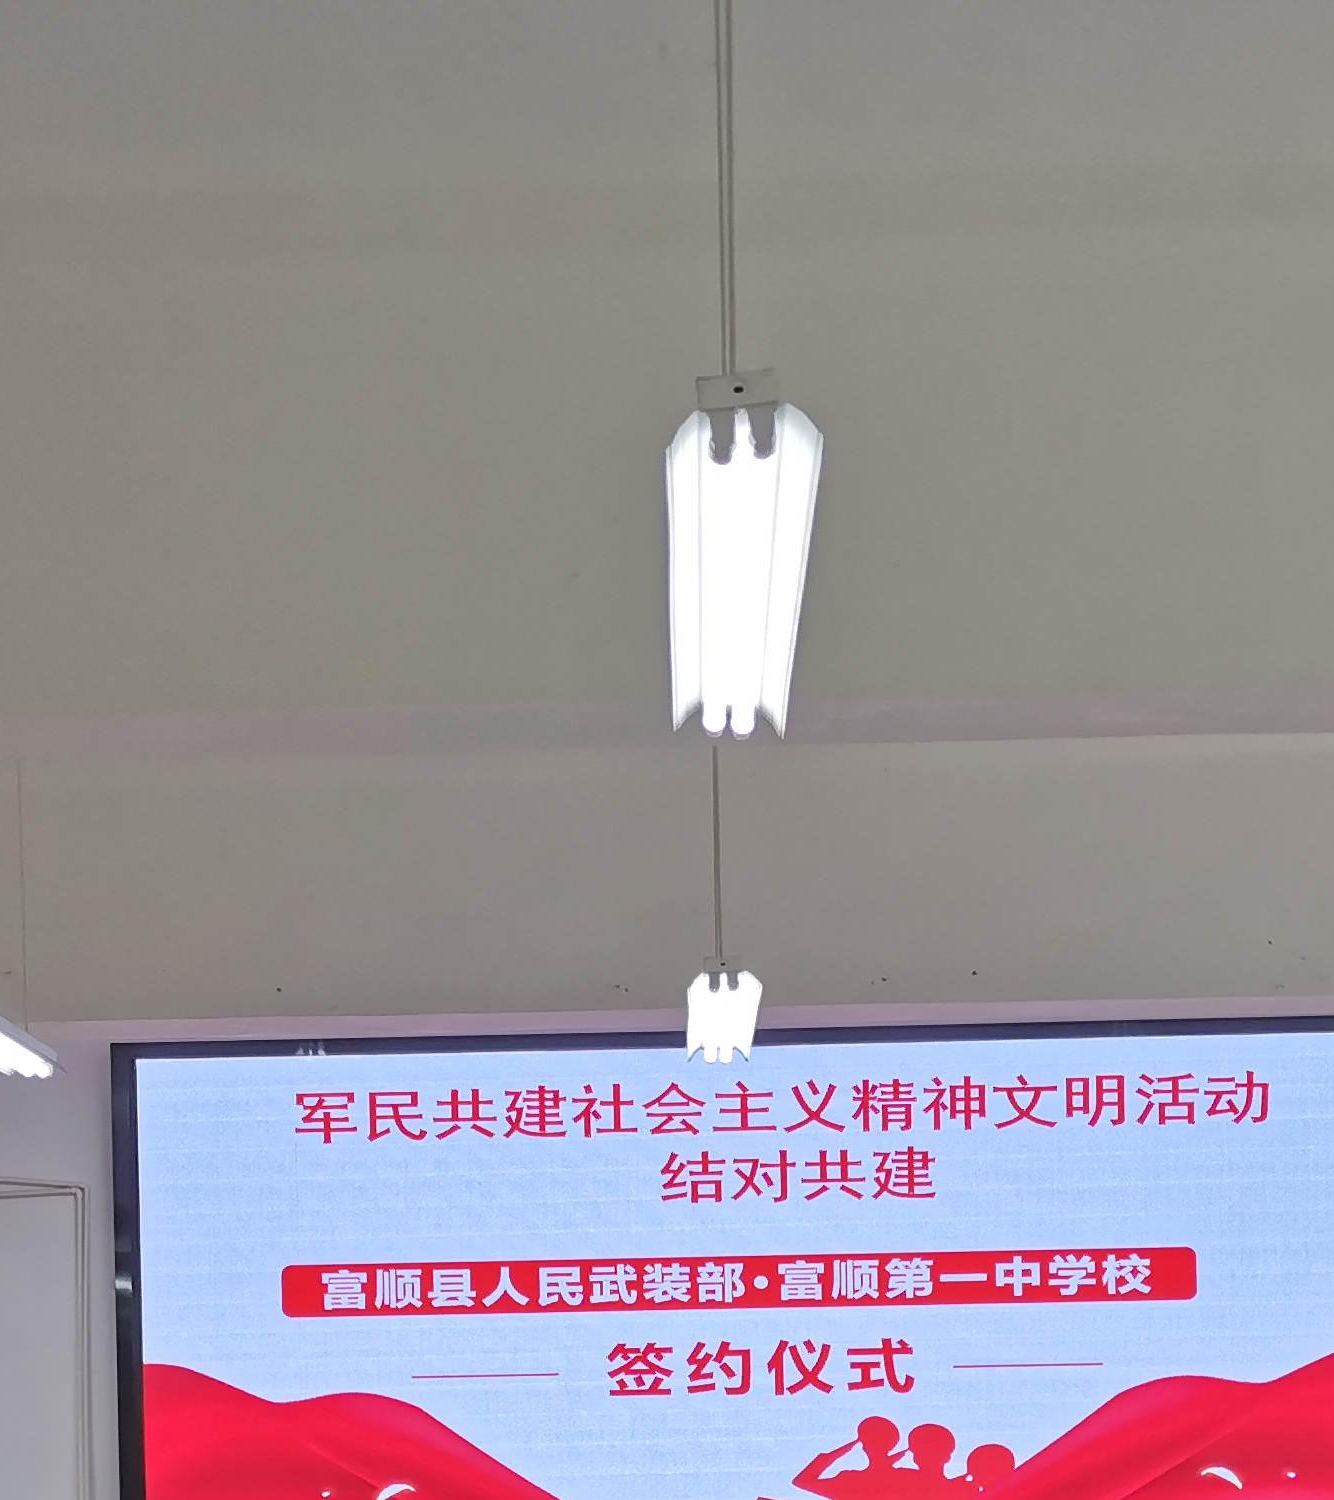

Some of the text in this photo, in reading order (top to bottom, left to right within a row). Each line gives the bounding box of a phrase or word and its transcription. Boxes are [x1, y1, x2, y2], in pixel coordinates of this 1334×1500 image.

[295, 1070, 1270, 1144] 军民共建社会主义精神文明活动
[660, 1145, 937, 1204] 结对共建
[320, 1253, 1152, 1312] 富顺县人民武装部·富顺第一中学校
[607, 1337, 916, 1397] 签约仪式
